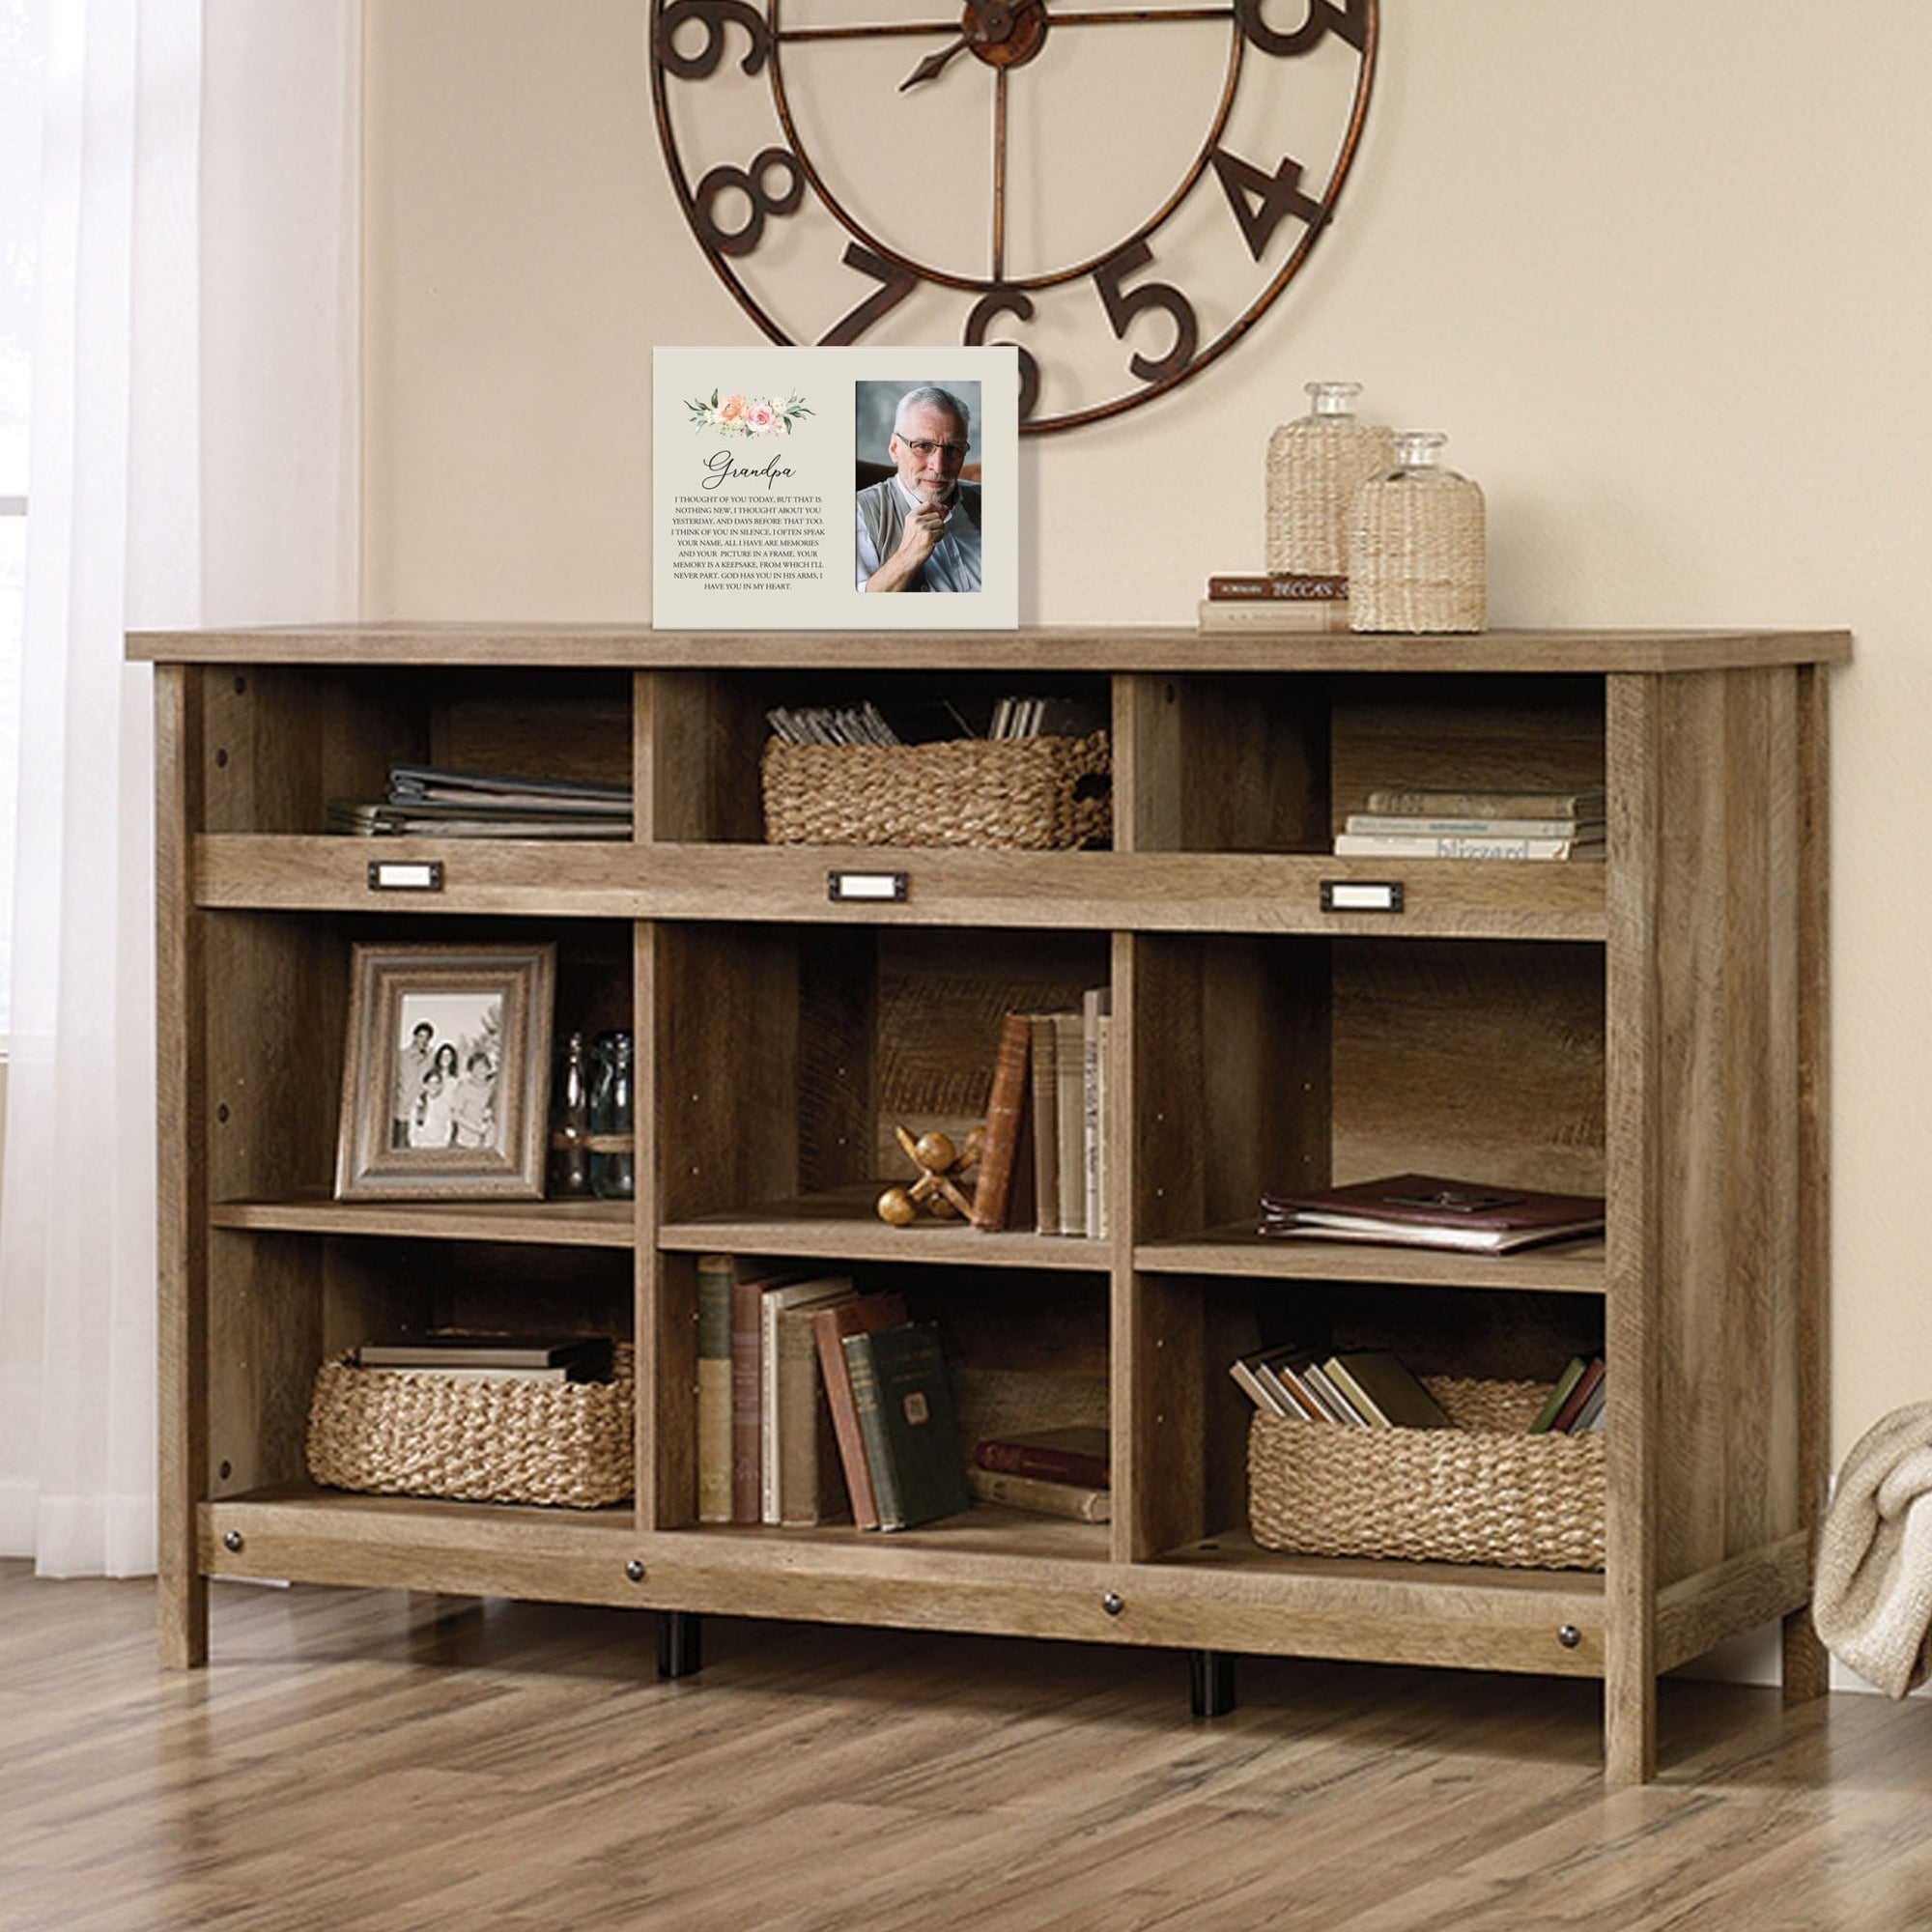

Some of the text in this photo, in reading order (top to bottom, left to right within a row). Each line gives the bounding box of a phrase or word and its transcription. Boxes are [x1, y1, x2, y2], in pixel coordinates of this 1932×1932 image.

[696, 147, 806, 257] 8
[1210, 146, 1332, 261] 4
[815, 242, 918, 347] 7
[1092, 240, 1198, 383] 5
[701, 450, 797, 490] Grandpa
[796, 572, 818, 581] ARMS,
